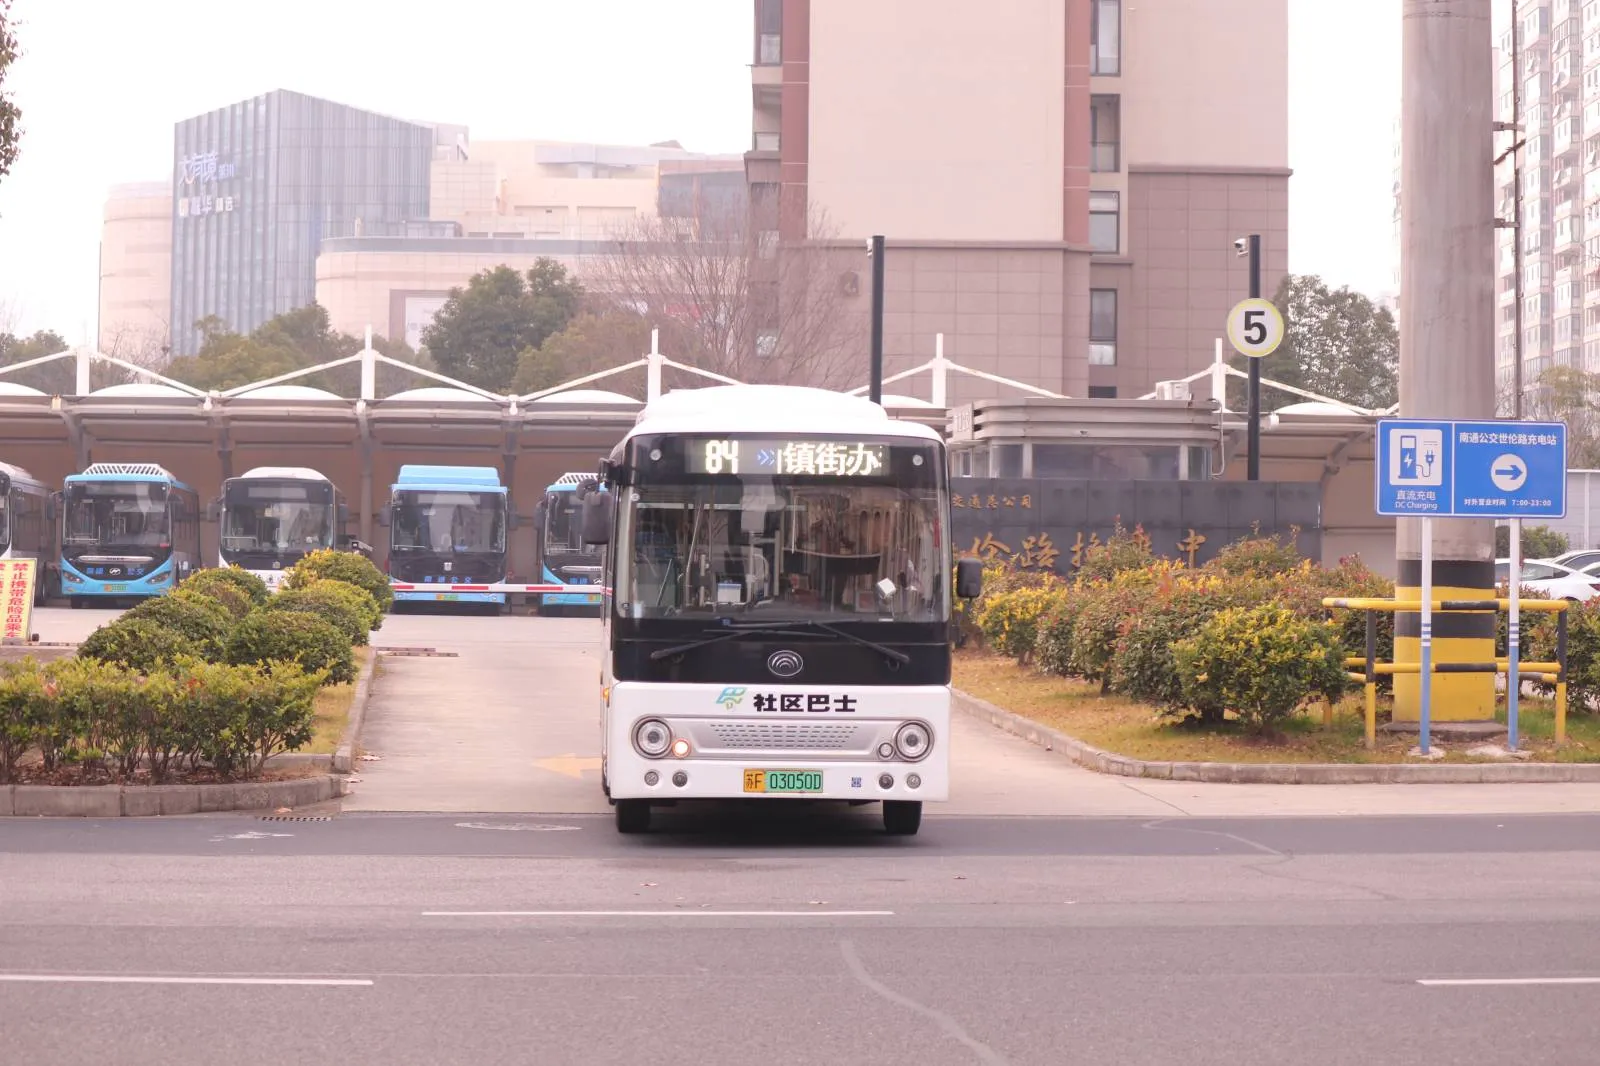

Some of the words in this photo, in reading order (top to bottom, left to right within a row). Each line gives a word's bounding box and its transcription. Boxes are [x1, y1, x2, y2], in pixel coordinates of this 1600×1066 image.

[1244, 311, 1267, 345] 5
[1459, 432, 1557, 446] 南通公交世伦路充电站
[705, 440, 739, 474] 84
[776, 442, 882, 476] 镇街办
[1396, 490, 1436, 500] 直流充电
[753, 694, 857, 713] 社区巴士
